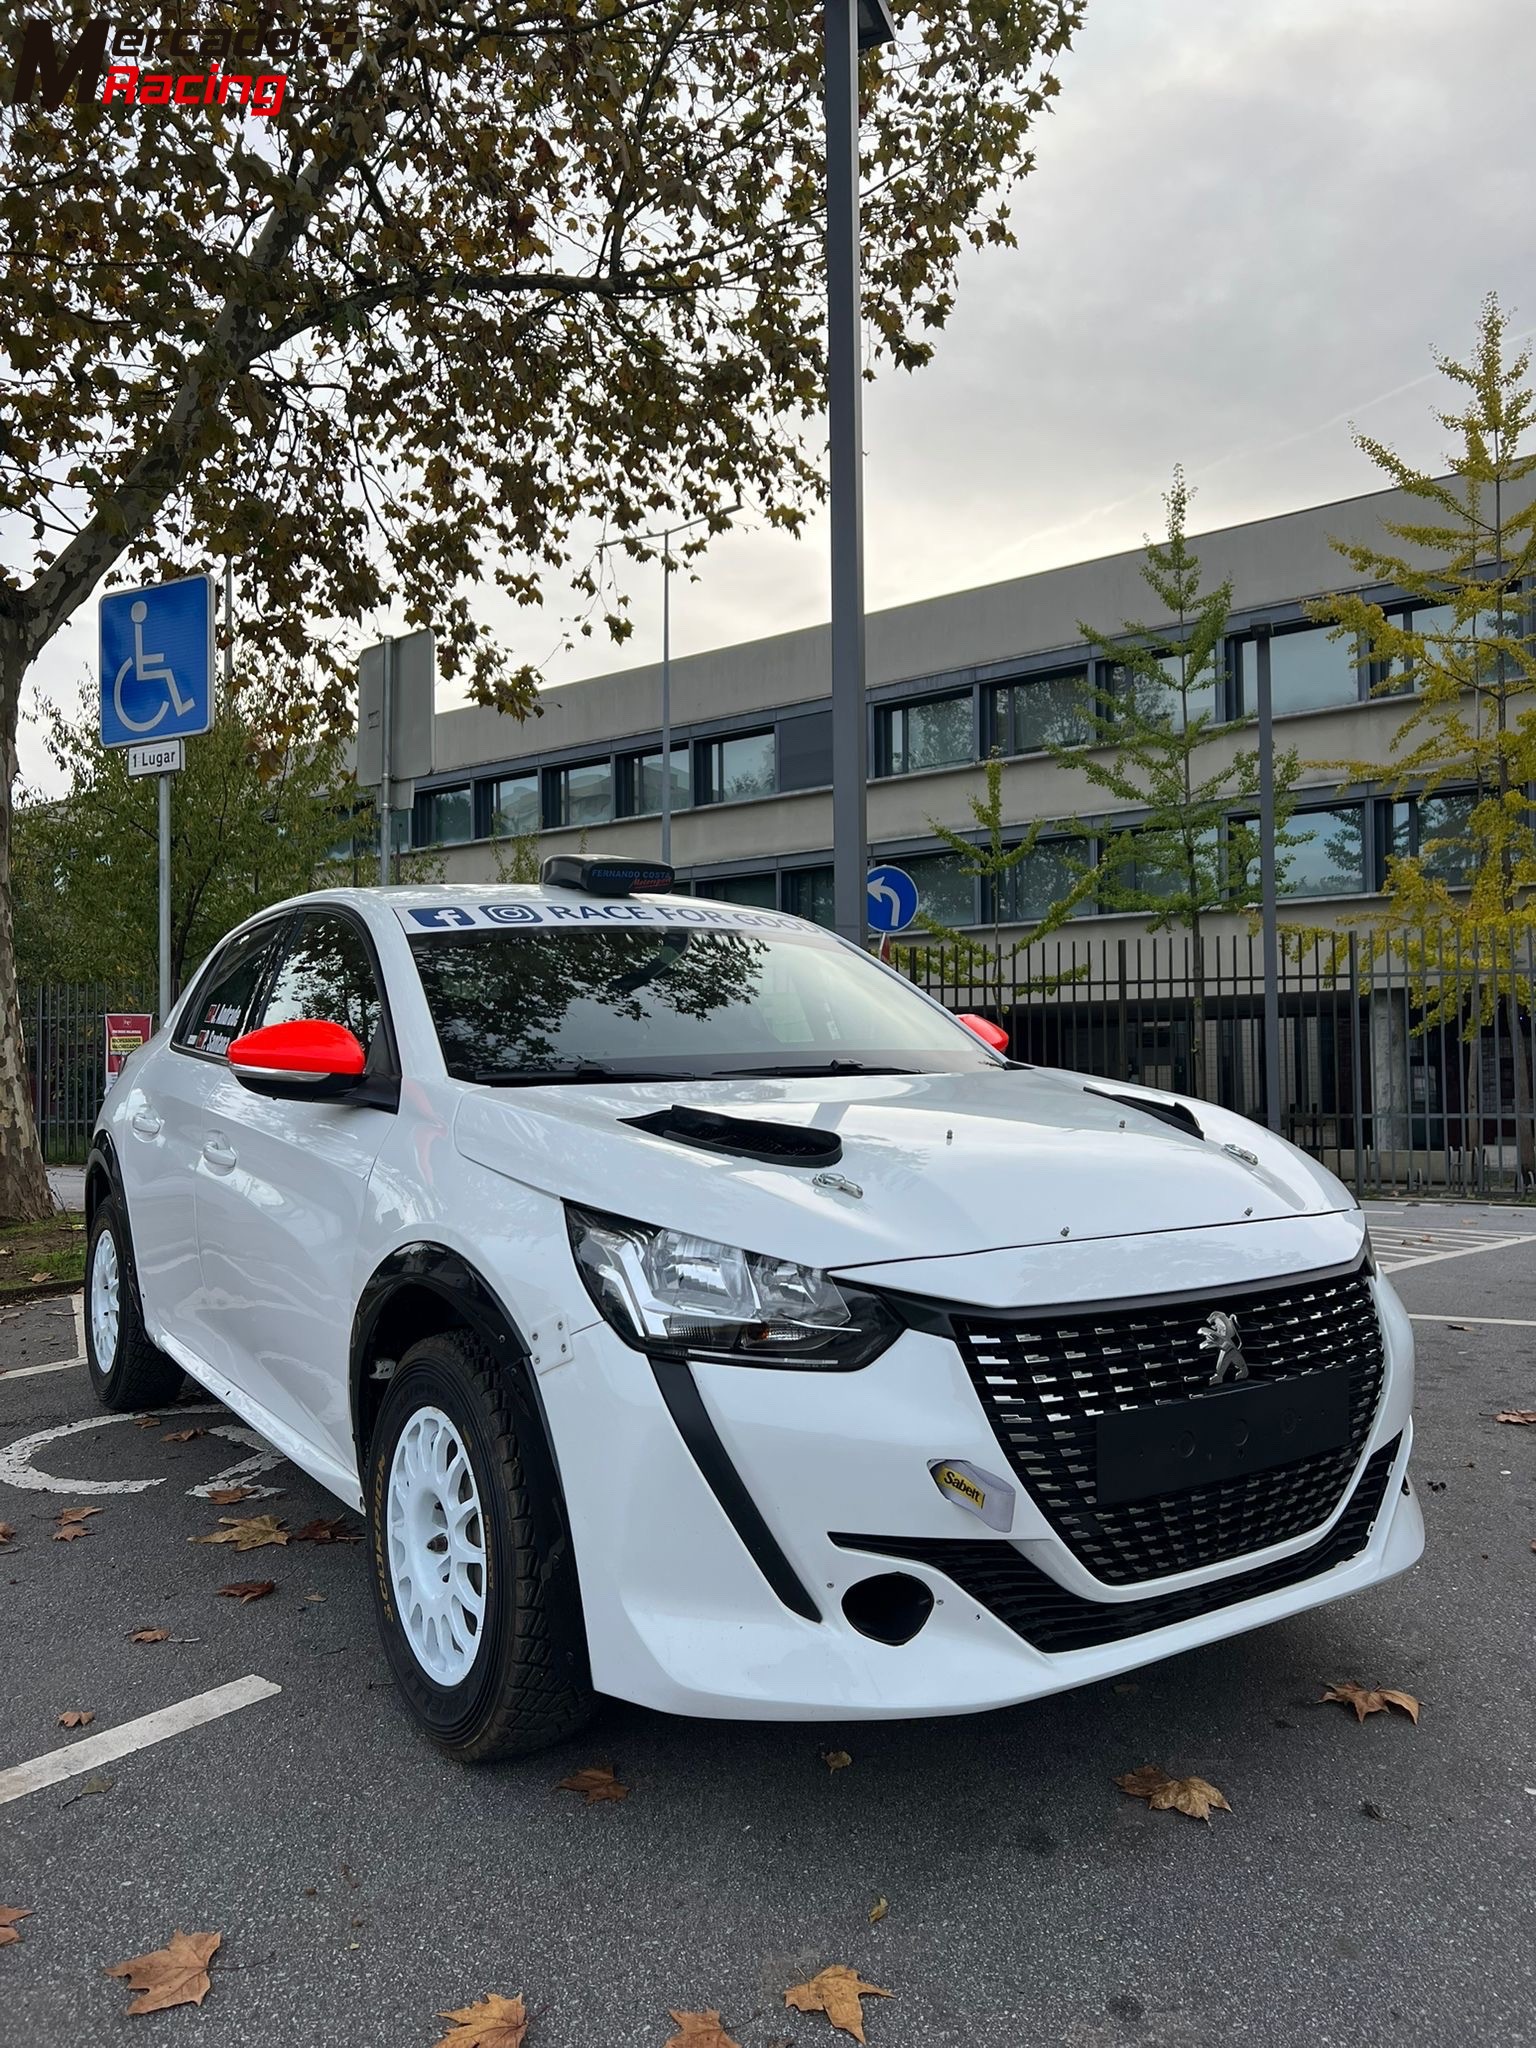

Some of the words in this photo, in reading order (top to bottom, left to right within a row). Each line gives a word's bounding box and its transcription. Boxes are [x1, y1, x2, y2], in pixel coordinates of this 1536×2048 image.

[132, 753, 138, 768] 1
[141, 751, 176, 767] Lugar
[591, 869, 641, 879] FERNANDO
[642, 871, 671, 880] COSTA
[546, 905, 654, 920] RACE
[655, 907, 732, 924] FOR
[732, 913, 821, 934] GOOD
[943, 1470, 981, 1503] Sabelt
